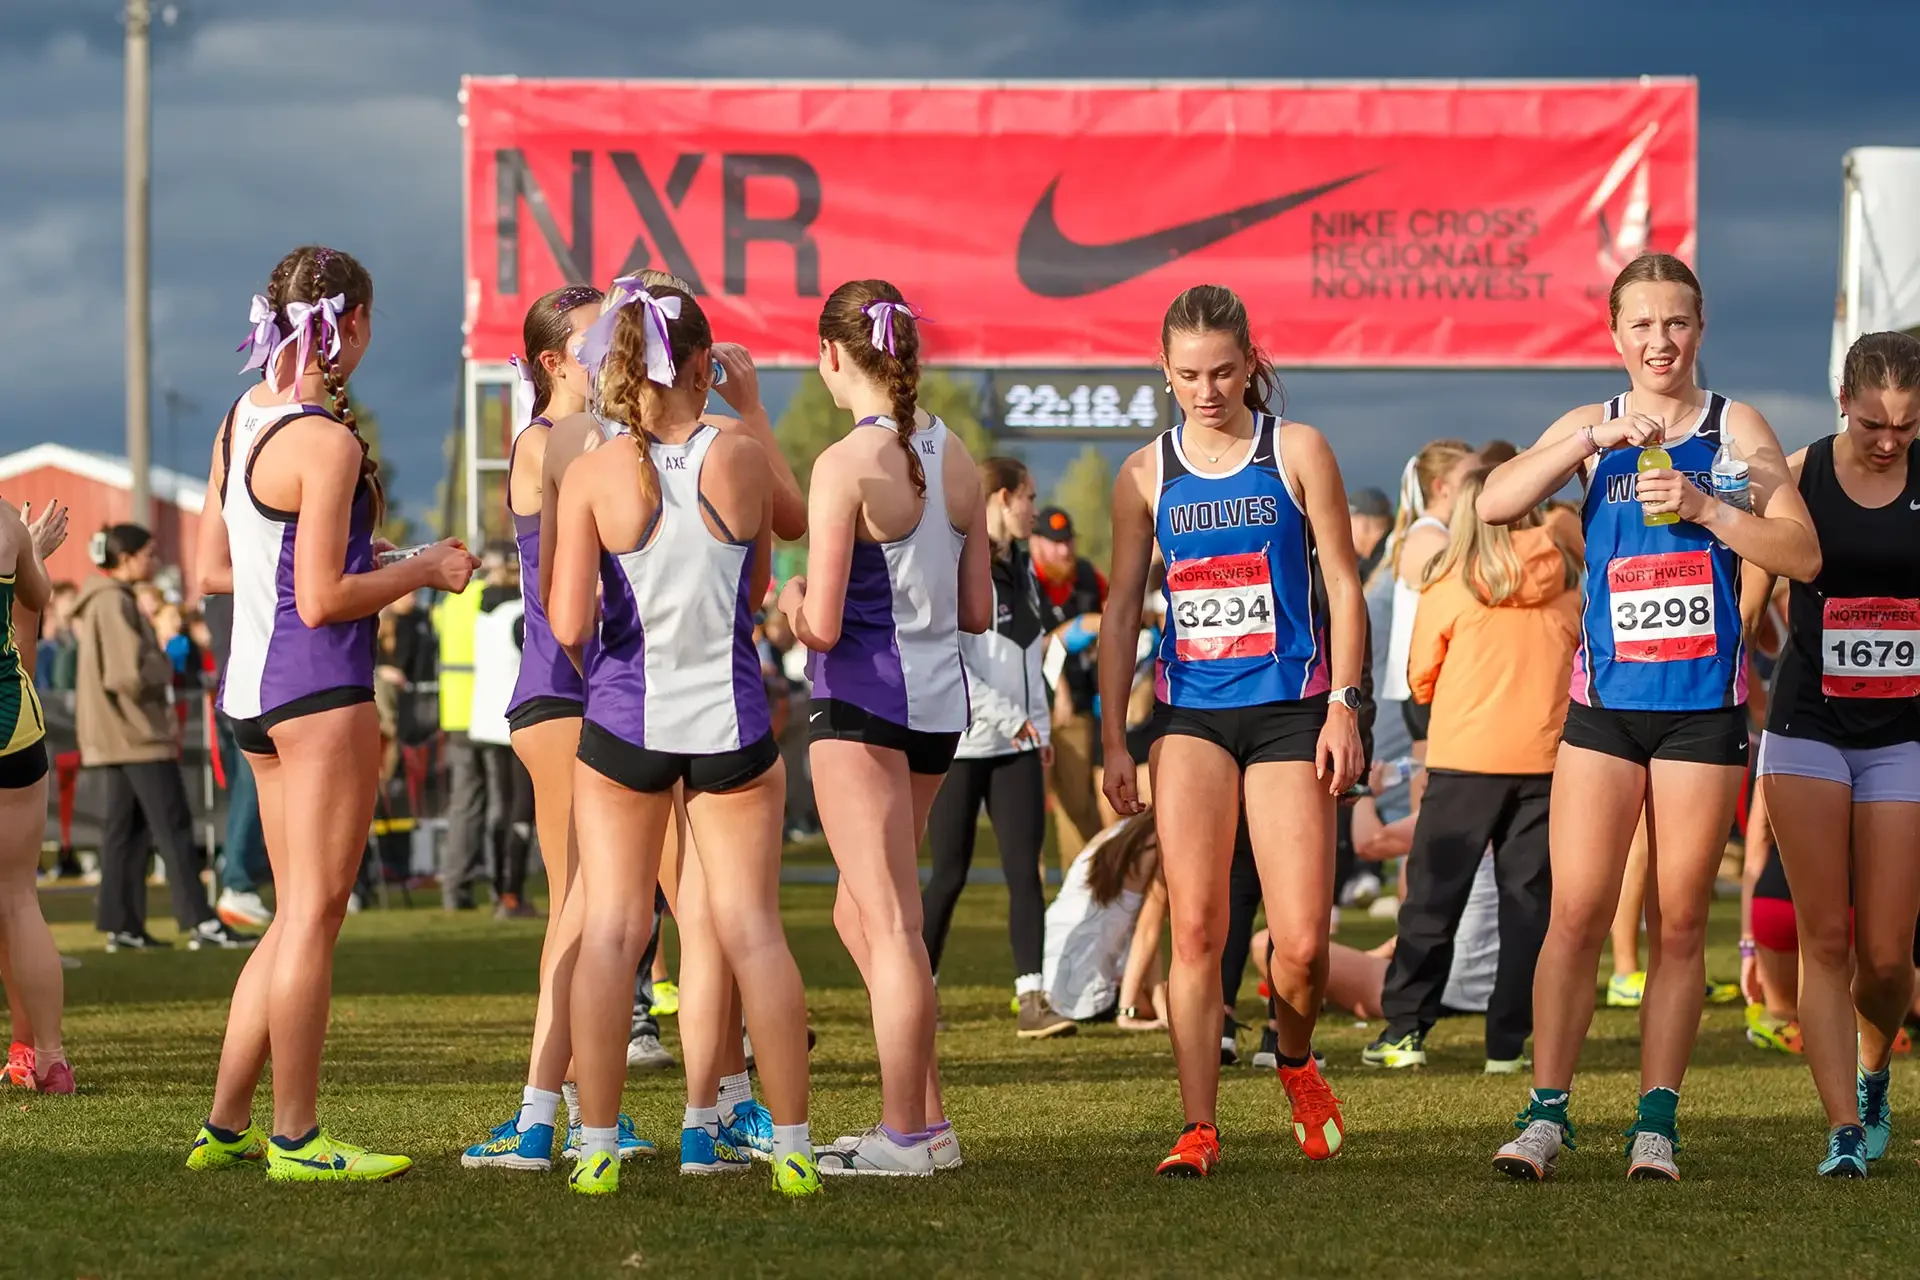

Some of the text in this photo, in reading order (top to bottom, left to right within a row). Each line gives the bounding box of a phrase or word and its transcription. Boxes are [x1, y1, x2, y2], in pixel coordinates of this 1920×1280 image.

[496, 148, 821, 297] NXR
[1311, 208, 1540, 239] NIKE CROSS
[1311, 241, 1529, 269] REGIONALS
[1311, 271, 1553, 301] NORTHWEST
[921, 440, 936, 455] AXE
[665, 456, 687, 470] AXE
[1169, 496, 1278, 535] WOLVES
[1174, 565, 1262, 583] NORTHWEST
[1615, 565, 1704, 583] NORTHWEST
[1177, 595, 1270, 628] 3294
[1617, 595, 1710, 631] 3298
[1830, 610, 1917, 621] NORTHWEST
[1831, 640, 1914, 667] 1679
